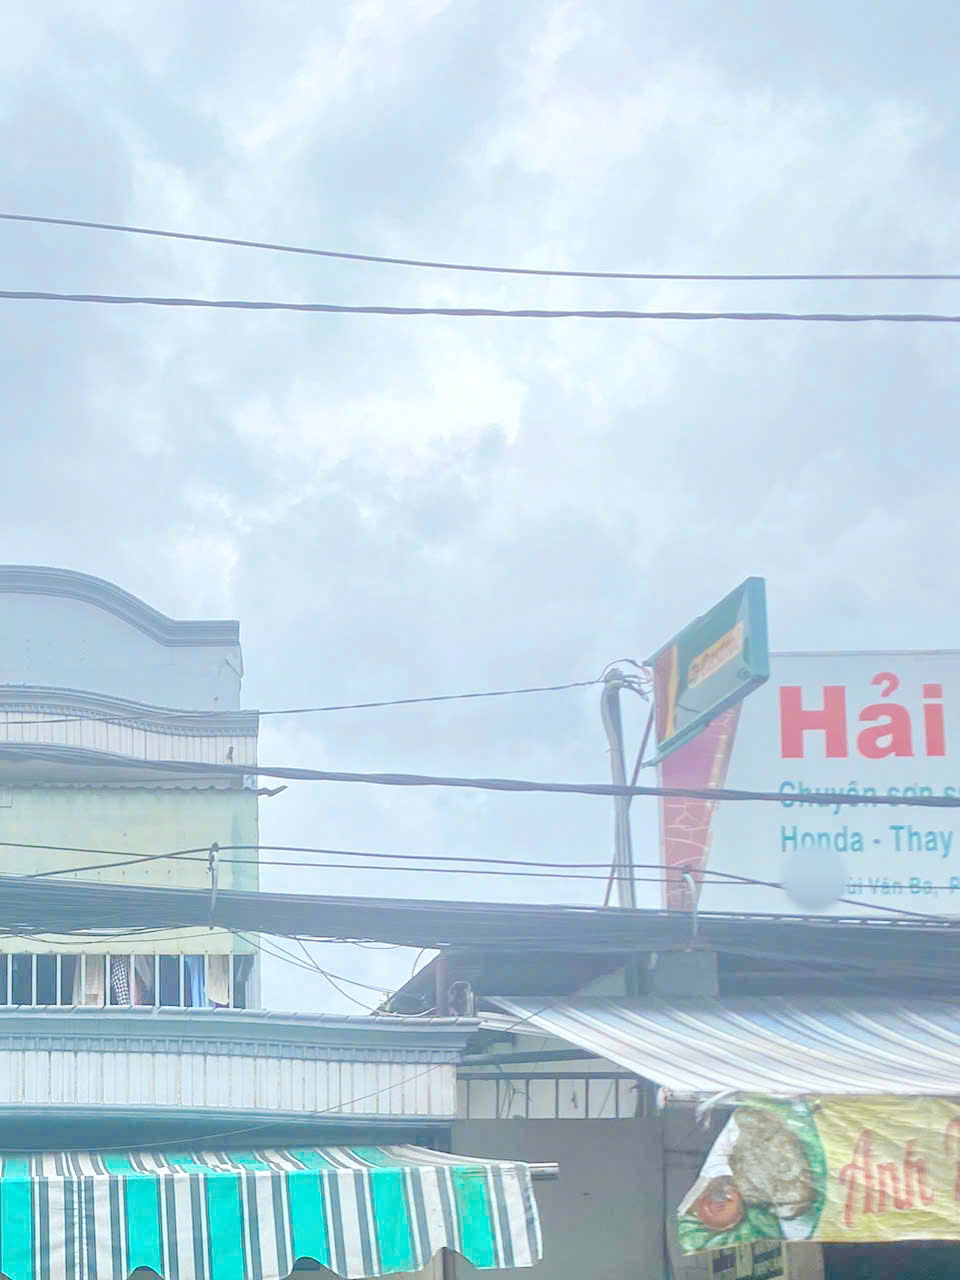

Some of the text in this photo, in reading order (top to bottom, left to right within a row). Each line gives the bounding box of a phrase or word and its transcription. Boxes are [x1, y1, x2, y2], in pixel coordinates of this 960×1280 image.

[778, 671, 946, 760] Hải
[780, 825, 865, 852] Honda
[890, 824, 953, 859] Thay
[837, 1128, 934, 1229] Anh
